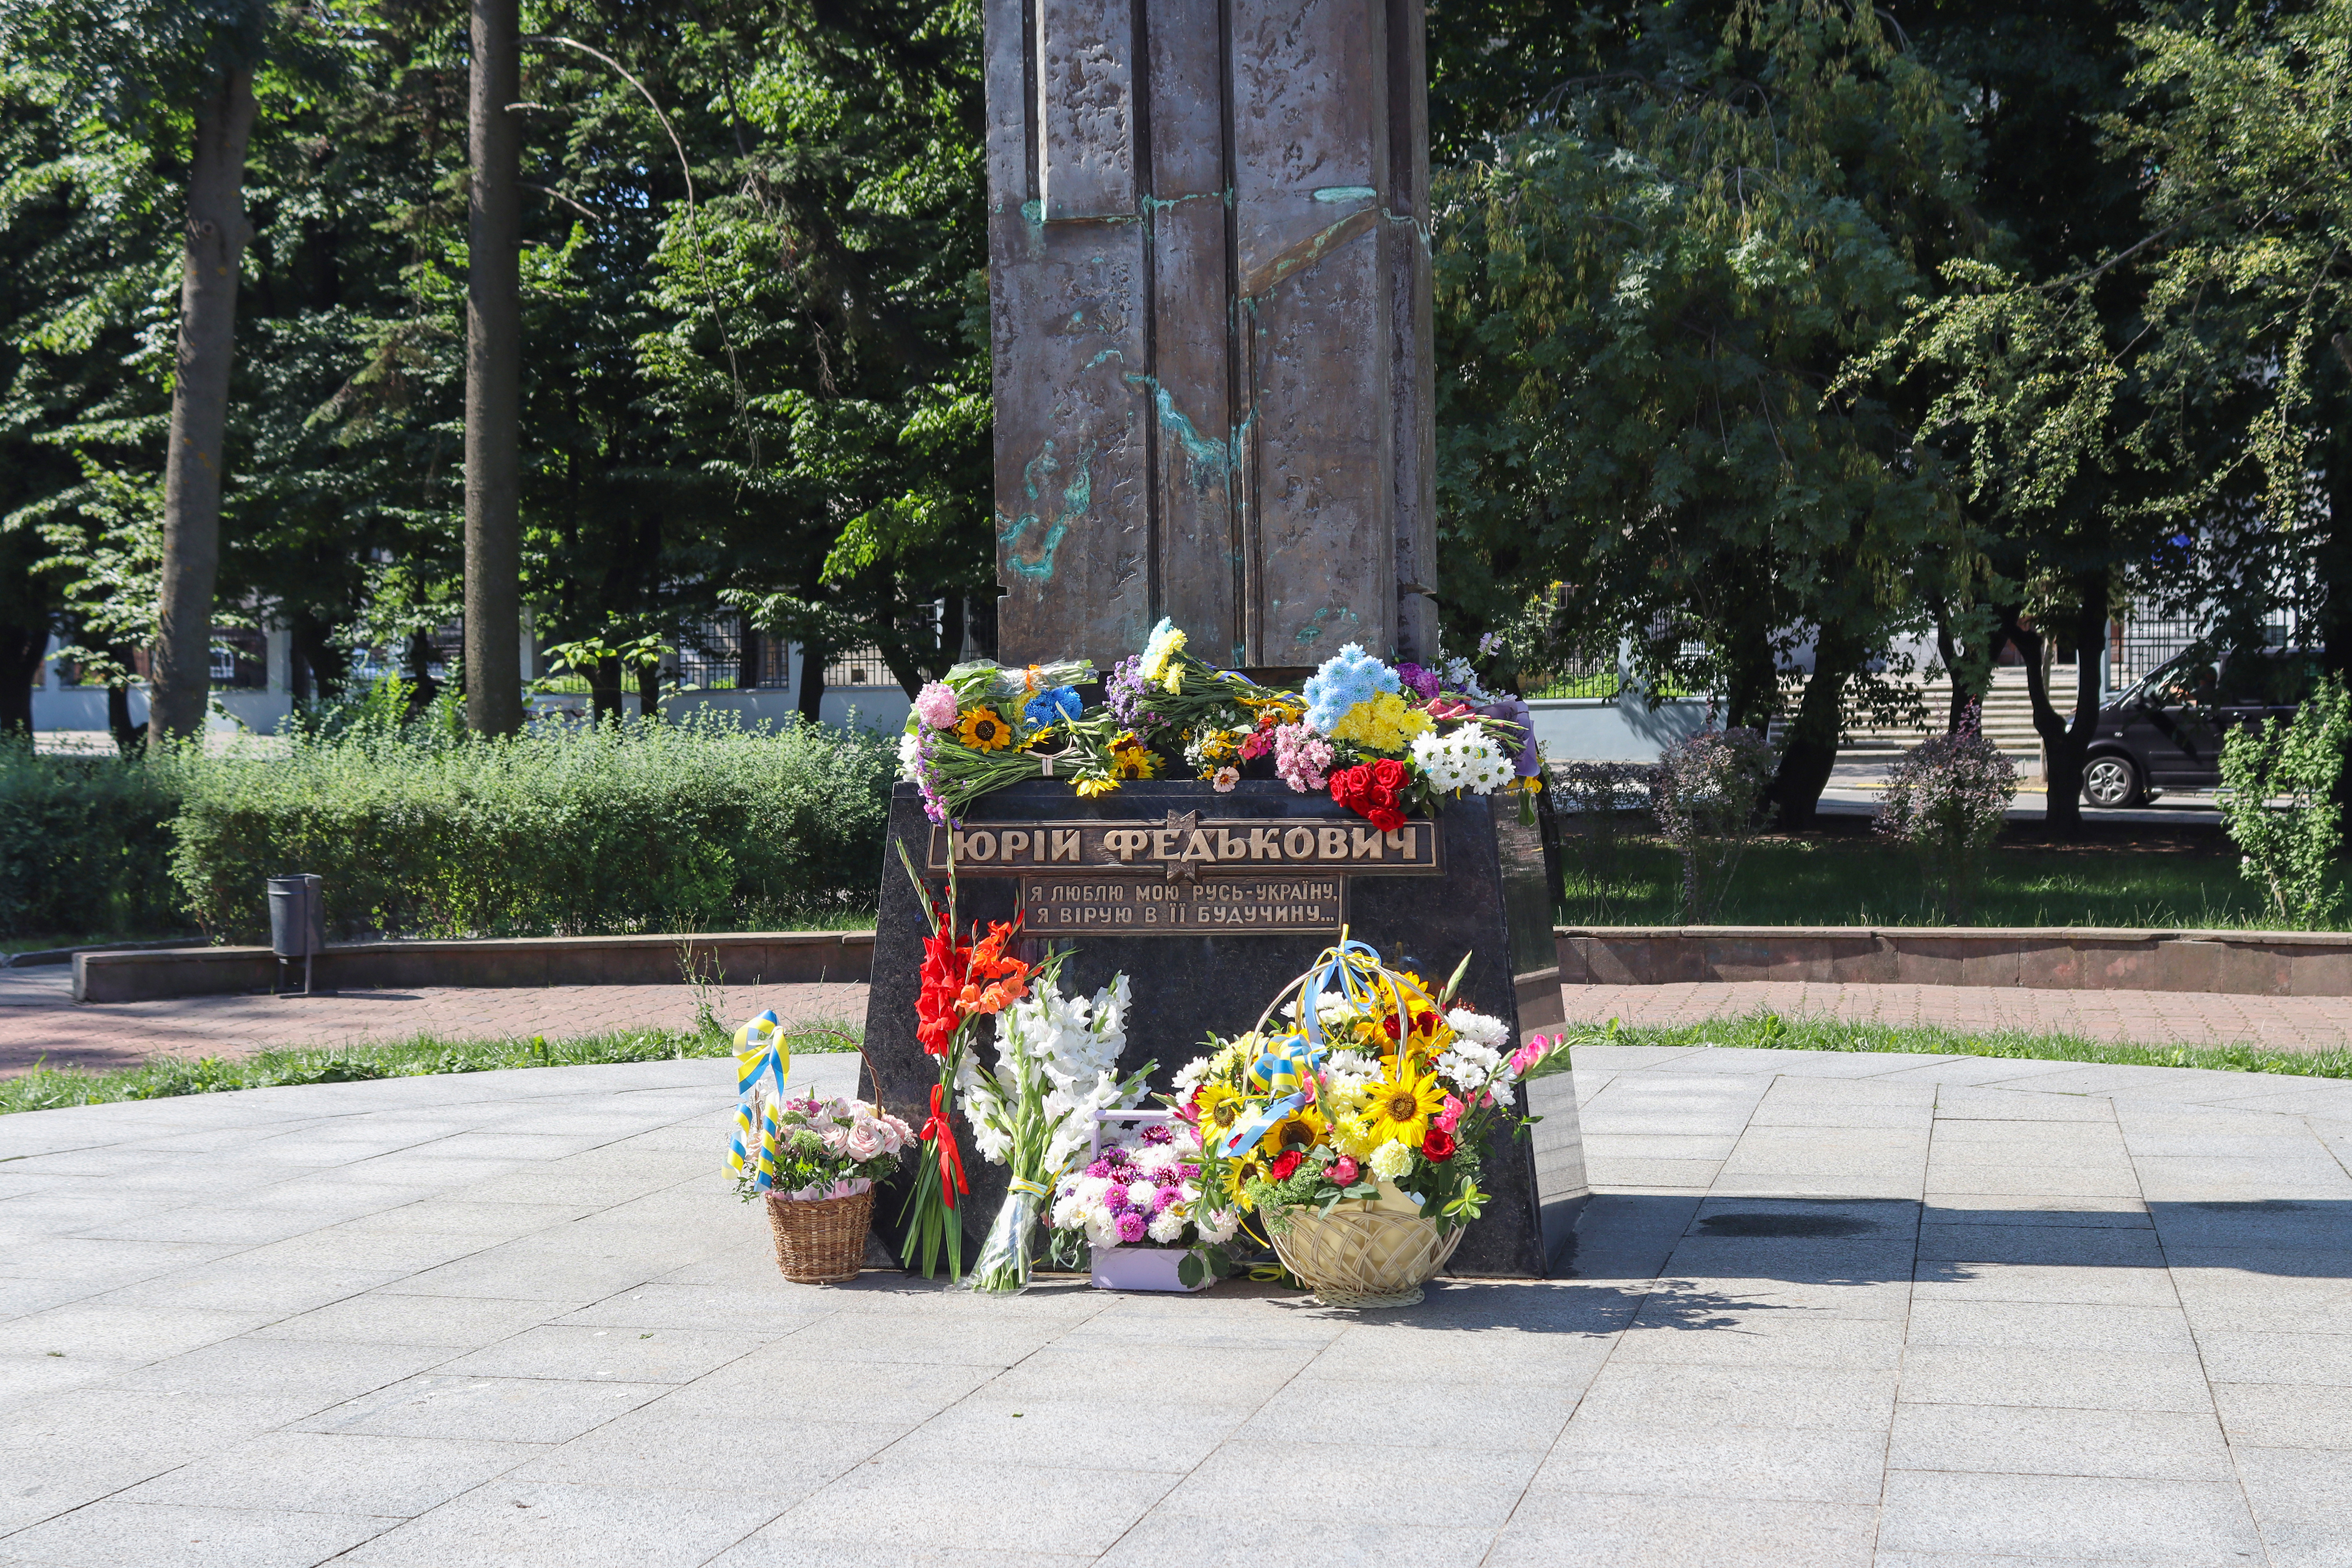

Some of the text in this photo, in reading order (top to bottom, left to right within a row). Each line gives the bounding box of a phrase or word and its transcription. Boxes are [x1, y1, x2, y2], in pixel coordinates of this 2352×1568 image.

[953, 827, 1416, 862] ЮРІЙ ФЕДЬКОВИЧ
[1030, 881, 1338, 902] Я ЛЮБЛЮ МОЮ РУСЬ-УКРАЇНУ,
[1037, 902, 1335, 924] Я ВІРУЮ В ЇЇ БУДУЧИНУ...
